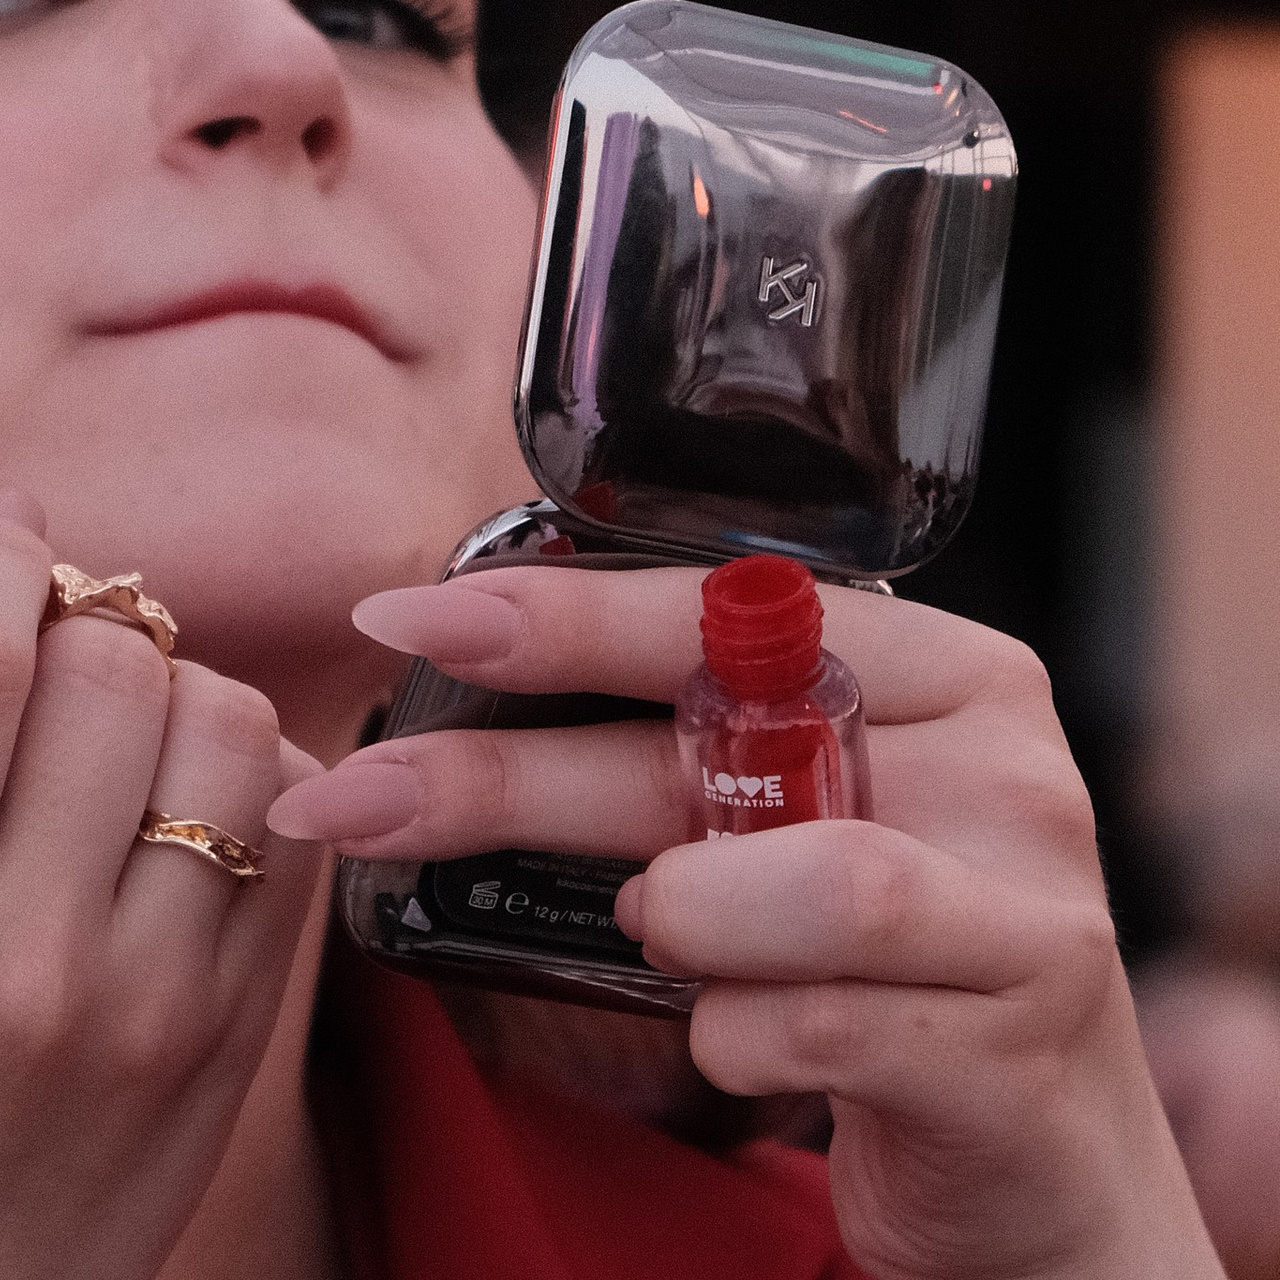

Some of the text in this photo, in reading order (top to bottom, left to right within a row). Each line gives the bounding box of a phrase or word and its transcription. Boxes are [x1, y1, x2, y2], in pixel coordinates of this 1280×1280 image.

[704, 790, 784, 808] GENERATION
[534, 905, 549, 918] 12
[550, 910, 560, 923] g
[568, 910, 596, 926] NET
